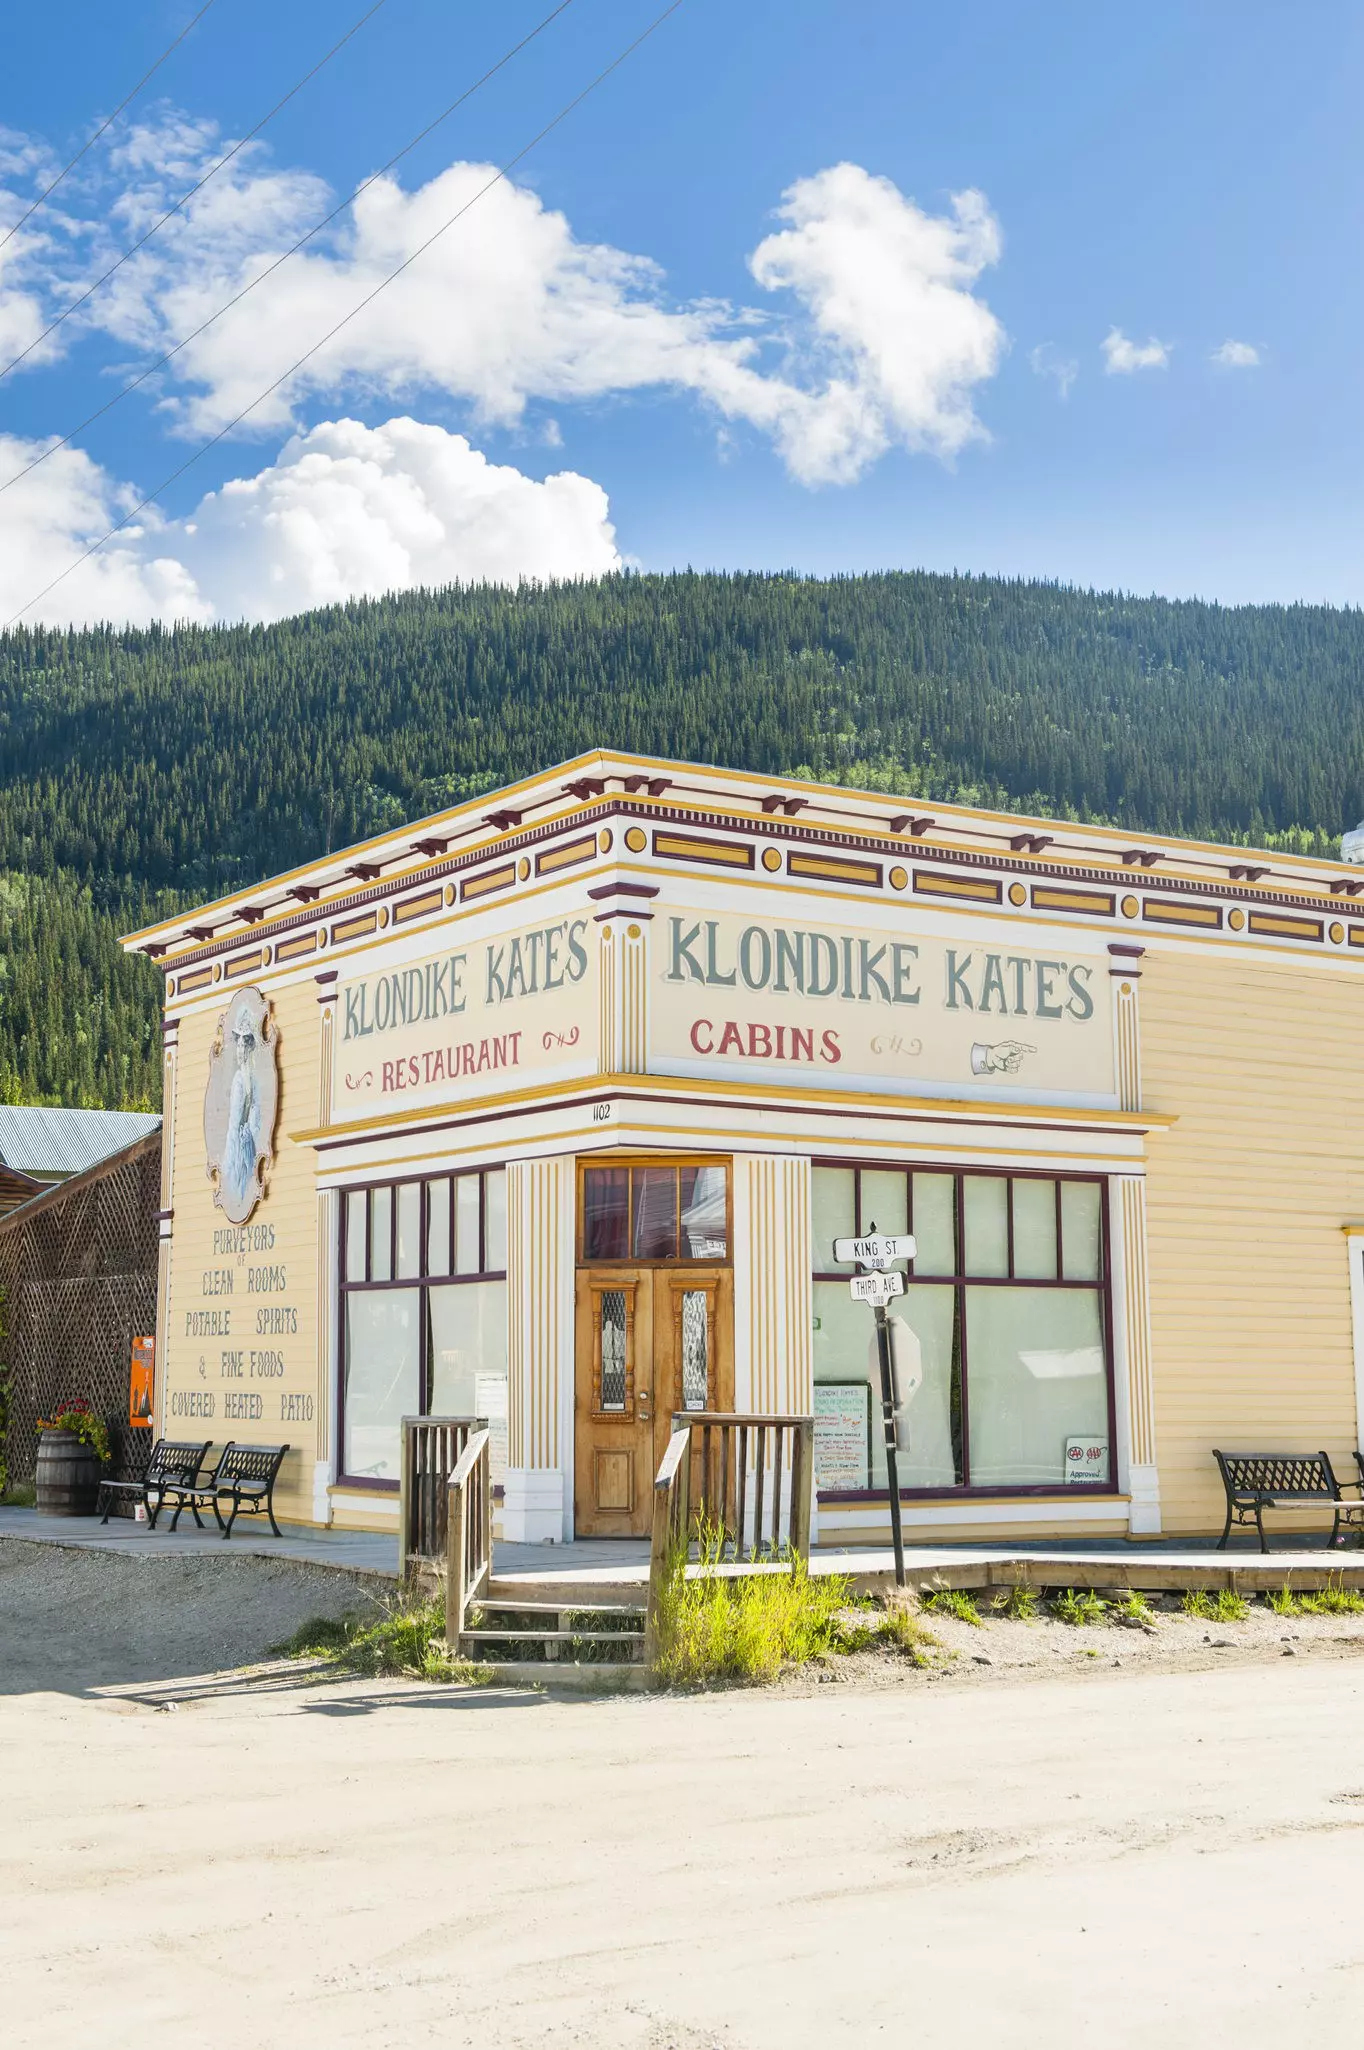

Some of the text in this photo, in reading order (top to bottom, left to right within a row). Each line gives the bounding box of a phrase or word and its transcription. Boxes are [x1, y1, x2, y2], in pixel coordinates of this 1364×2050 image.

[343, 919, 589, 1041] KLONDIKE KATE'S
[666, 916, 1094, 1021] KLONDIKE KATE'S
[689, 1018, 842, 1064] CABINS
[381, 1030, 522, 1092] RESTAURANT
[593, 1104, 611, 1121] 1102
[213, 1223, 275, 1255] PURVEYORS
[854, 1241, 878, 1257] KING
[237, 1254, 246, 1266] OF
[871, 1258, 885, 1268] 200
[202, 1266, 287, 1296] CLEAN ROOMS
[855, 1279, 877, 1296] THIRD
[185, 1308, 298, 1337] POTABLE SPIRITS
[221, 1351, 244, 1378] FINE
[250, 1350, 284, 1378] FOODS
[171, 1391, 314, 1421] COVERED HEATED PATIO
[1070, 1470, 1100, 1478] Approved
